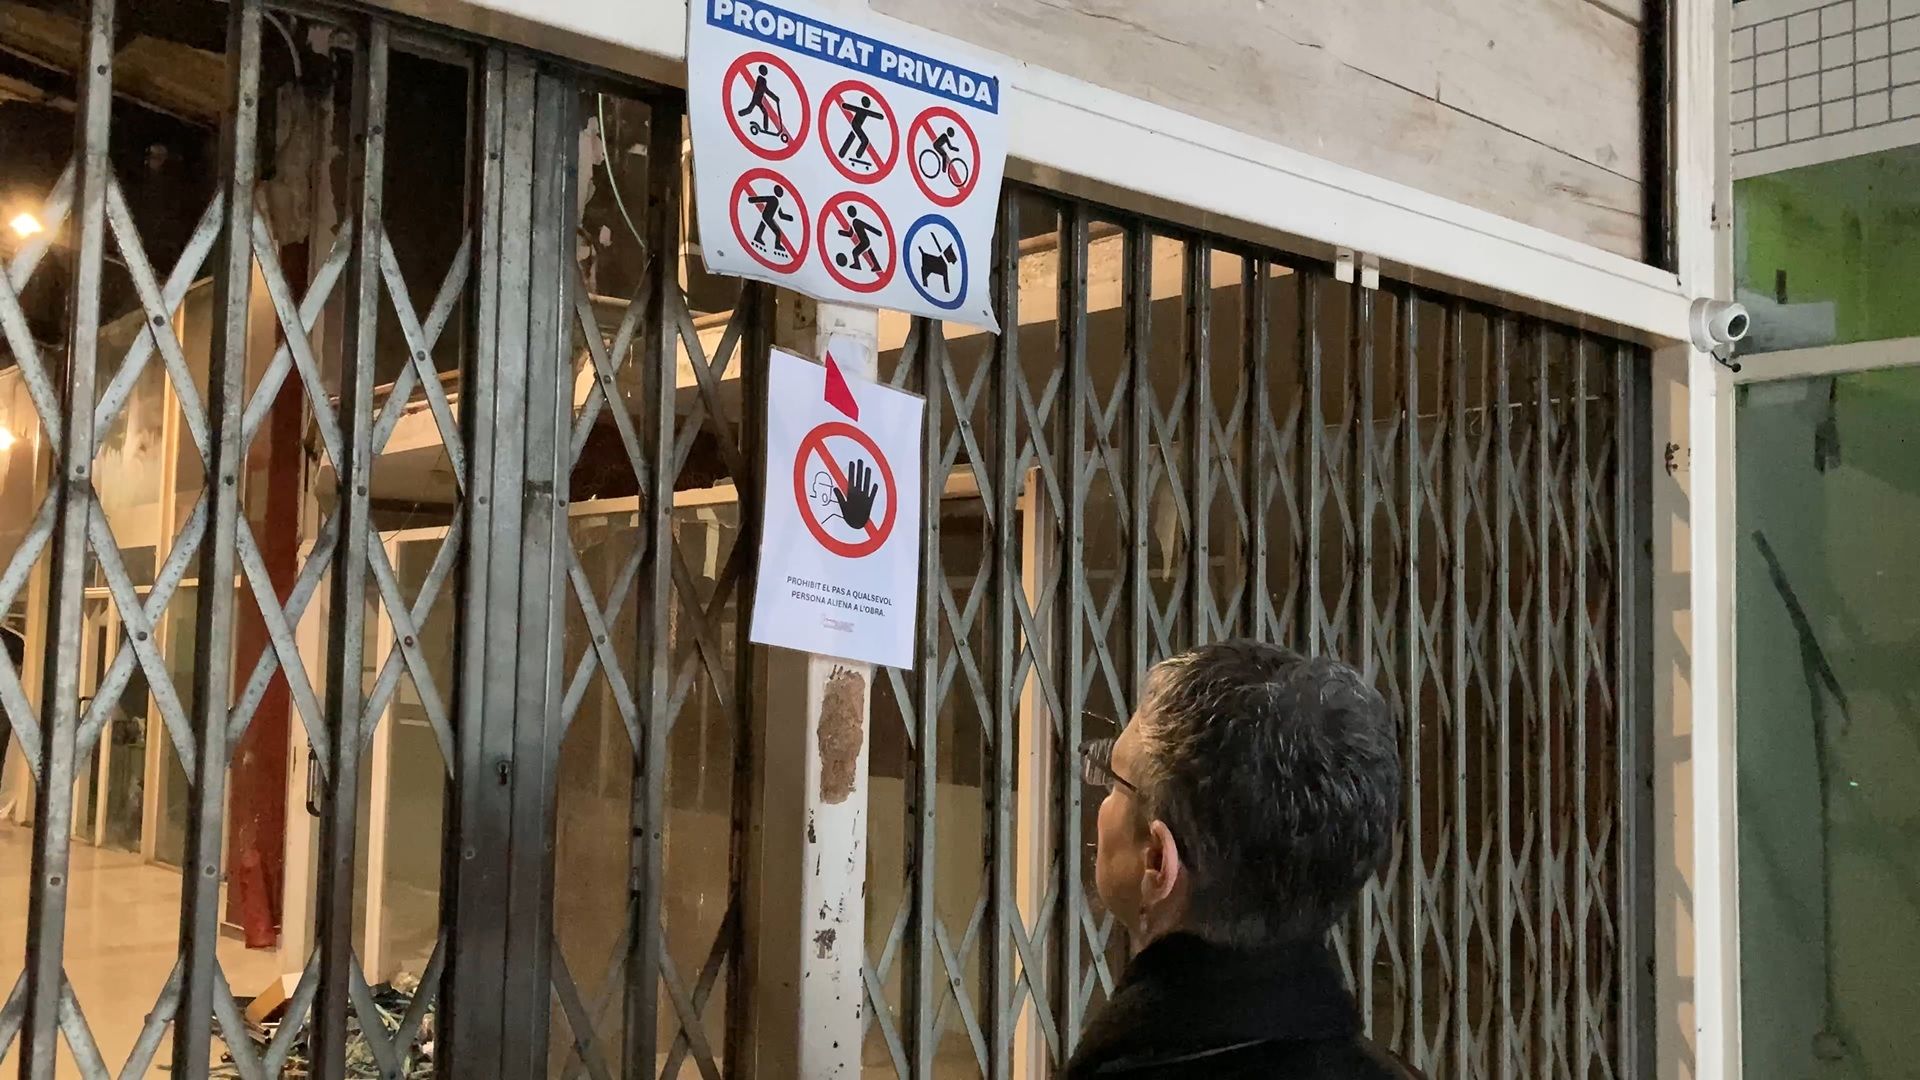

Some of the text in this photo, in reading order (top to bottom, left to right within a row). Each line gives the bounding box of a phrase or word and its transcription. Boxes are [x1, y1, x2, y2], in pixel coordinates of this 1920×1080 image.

[714, 0, 993, 106] PROPIETAT PRIVADA
[787, 575, 892, 606] PROHIBIT EL PAS A QUALSEVOL
[791, 590, 826, 604] PERSONA
[827, 598, 852, 610] ALIENA
[860, 605, 885, 616] L'OBRA.
